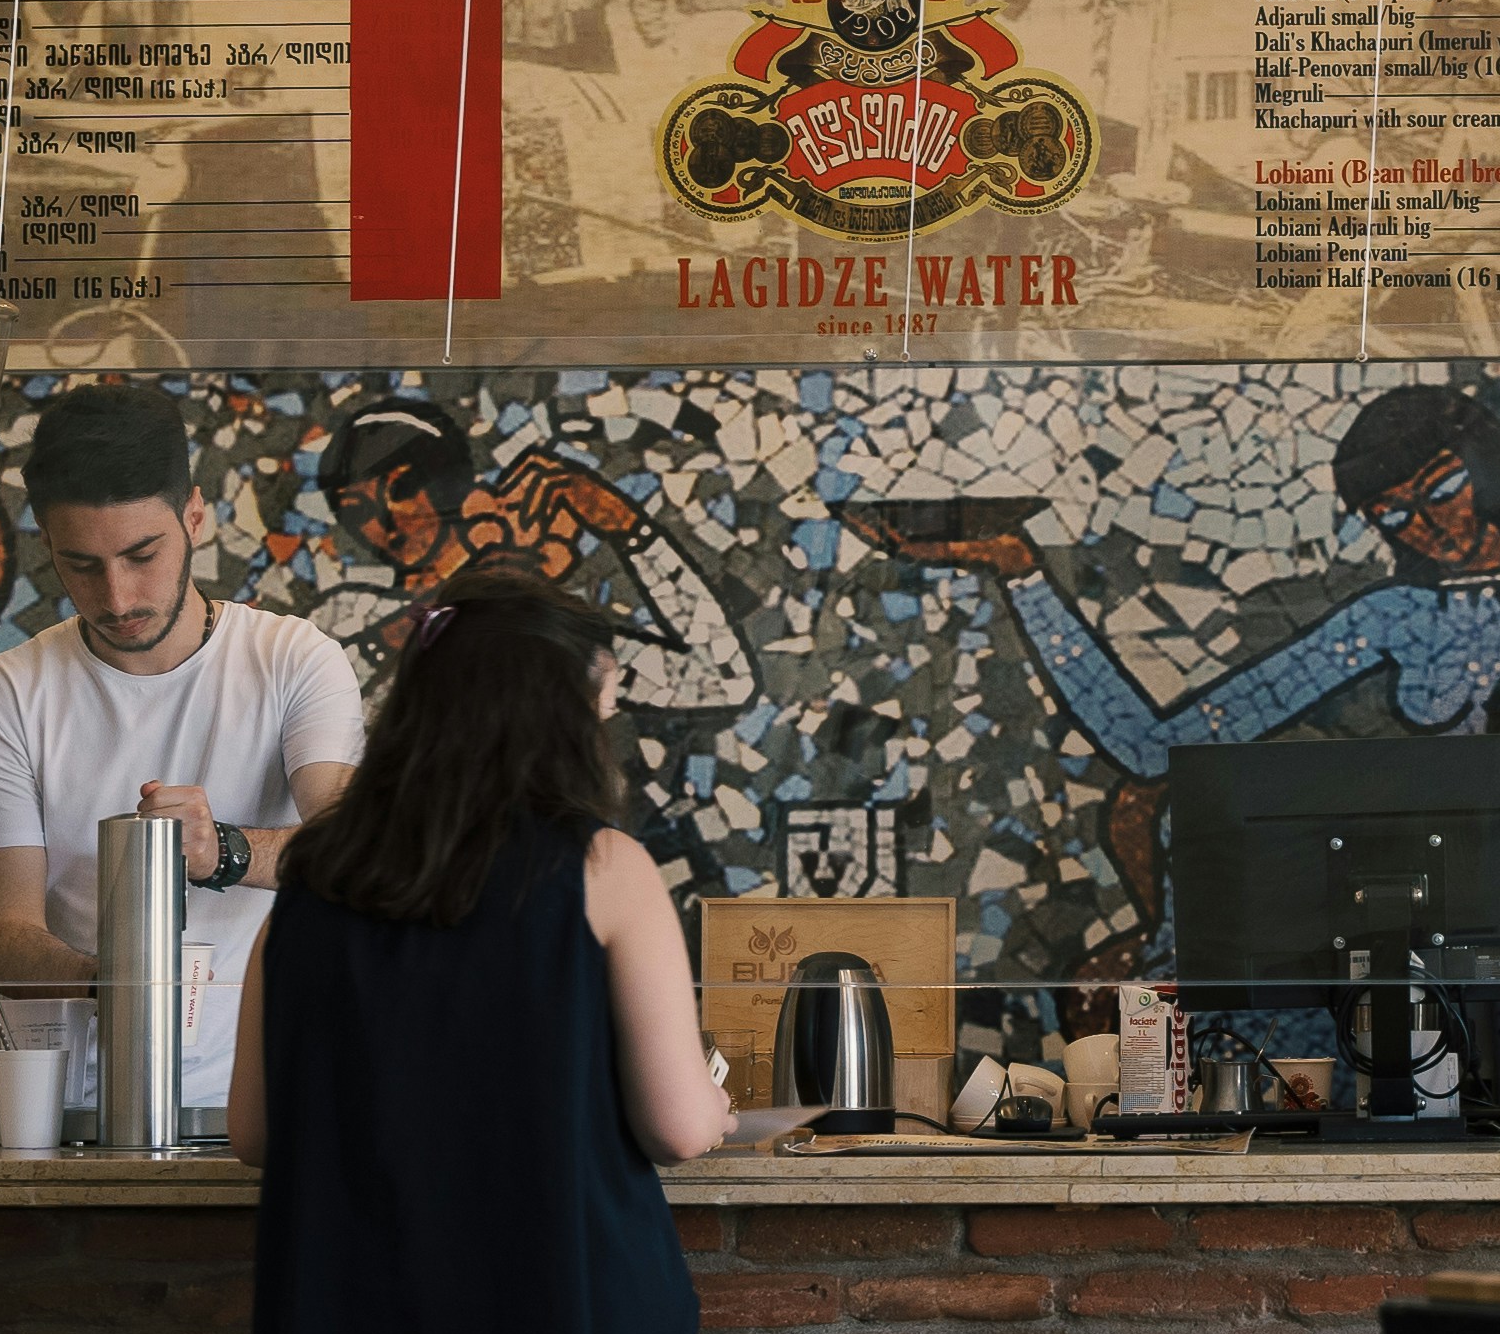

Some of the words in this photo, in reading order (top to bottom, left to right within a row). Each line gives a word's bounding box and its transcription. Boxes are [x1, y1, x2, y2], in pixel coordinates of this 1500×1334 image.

[1255, 6, 1325, 30] Adjaruli
[1331, 4, 1416, 29] small/big
[45, 43, 131, 66] მაწვნის
[139, 43, 211, 66] ცომზე
[1255, 31, 1305, 52] Dali's
[1311, 31, 1412, 55] Khachapuri
[1419, 30, 1492, 54] (Imeruli
[1255, 57, 1377, 78] Half-Penovani
[1384, 55, 1468, 79] small/big
[1255, 83, 1324, 106] Megruli
[1255, 109, 1357, 132] Khachapuri
[1363, 108, 1401, 128] with
[1407, 113, 1447, 128] sour
[1255, 160, 1334, 184] Lobiani
[1341, 159, 1405, 186] (Bean
[1412, 158, 1464, 183] filled
[1255, 191, 1321, 211] Lobiani
[1327, 190, 1390, 211] Imeruli
[1396, 189, 1481, 213] small/big
[1255, 217, 1321, 237] Lobiani
[1327, 216, 1398, 240] Adjaruli
[1404, 216, 1431, 239] big
[1255, 242, 1321, 263] Lobiani
[1327, 242, 1408, 263] Penovani
[677, 257, 888, 308] LAGIDZE
[915, 255, 1079, 306] WATER
[1255, 268, 1321, 288] Lobiani
[1327, 268, 1451, 288] Half-Penovani
[1457, 266, 1490, 289] (16
[817, 314, 873, 336] since
[885, 313, 938, 335] 1887
